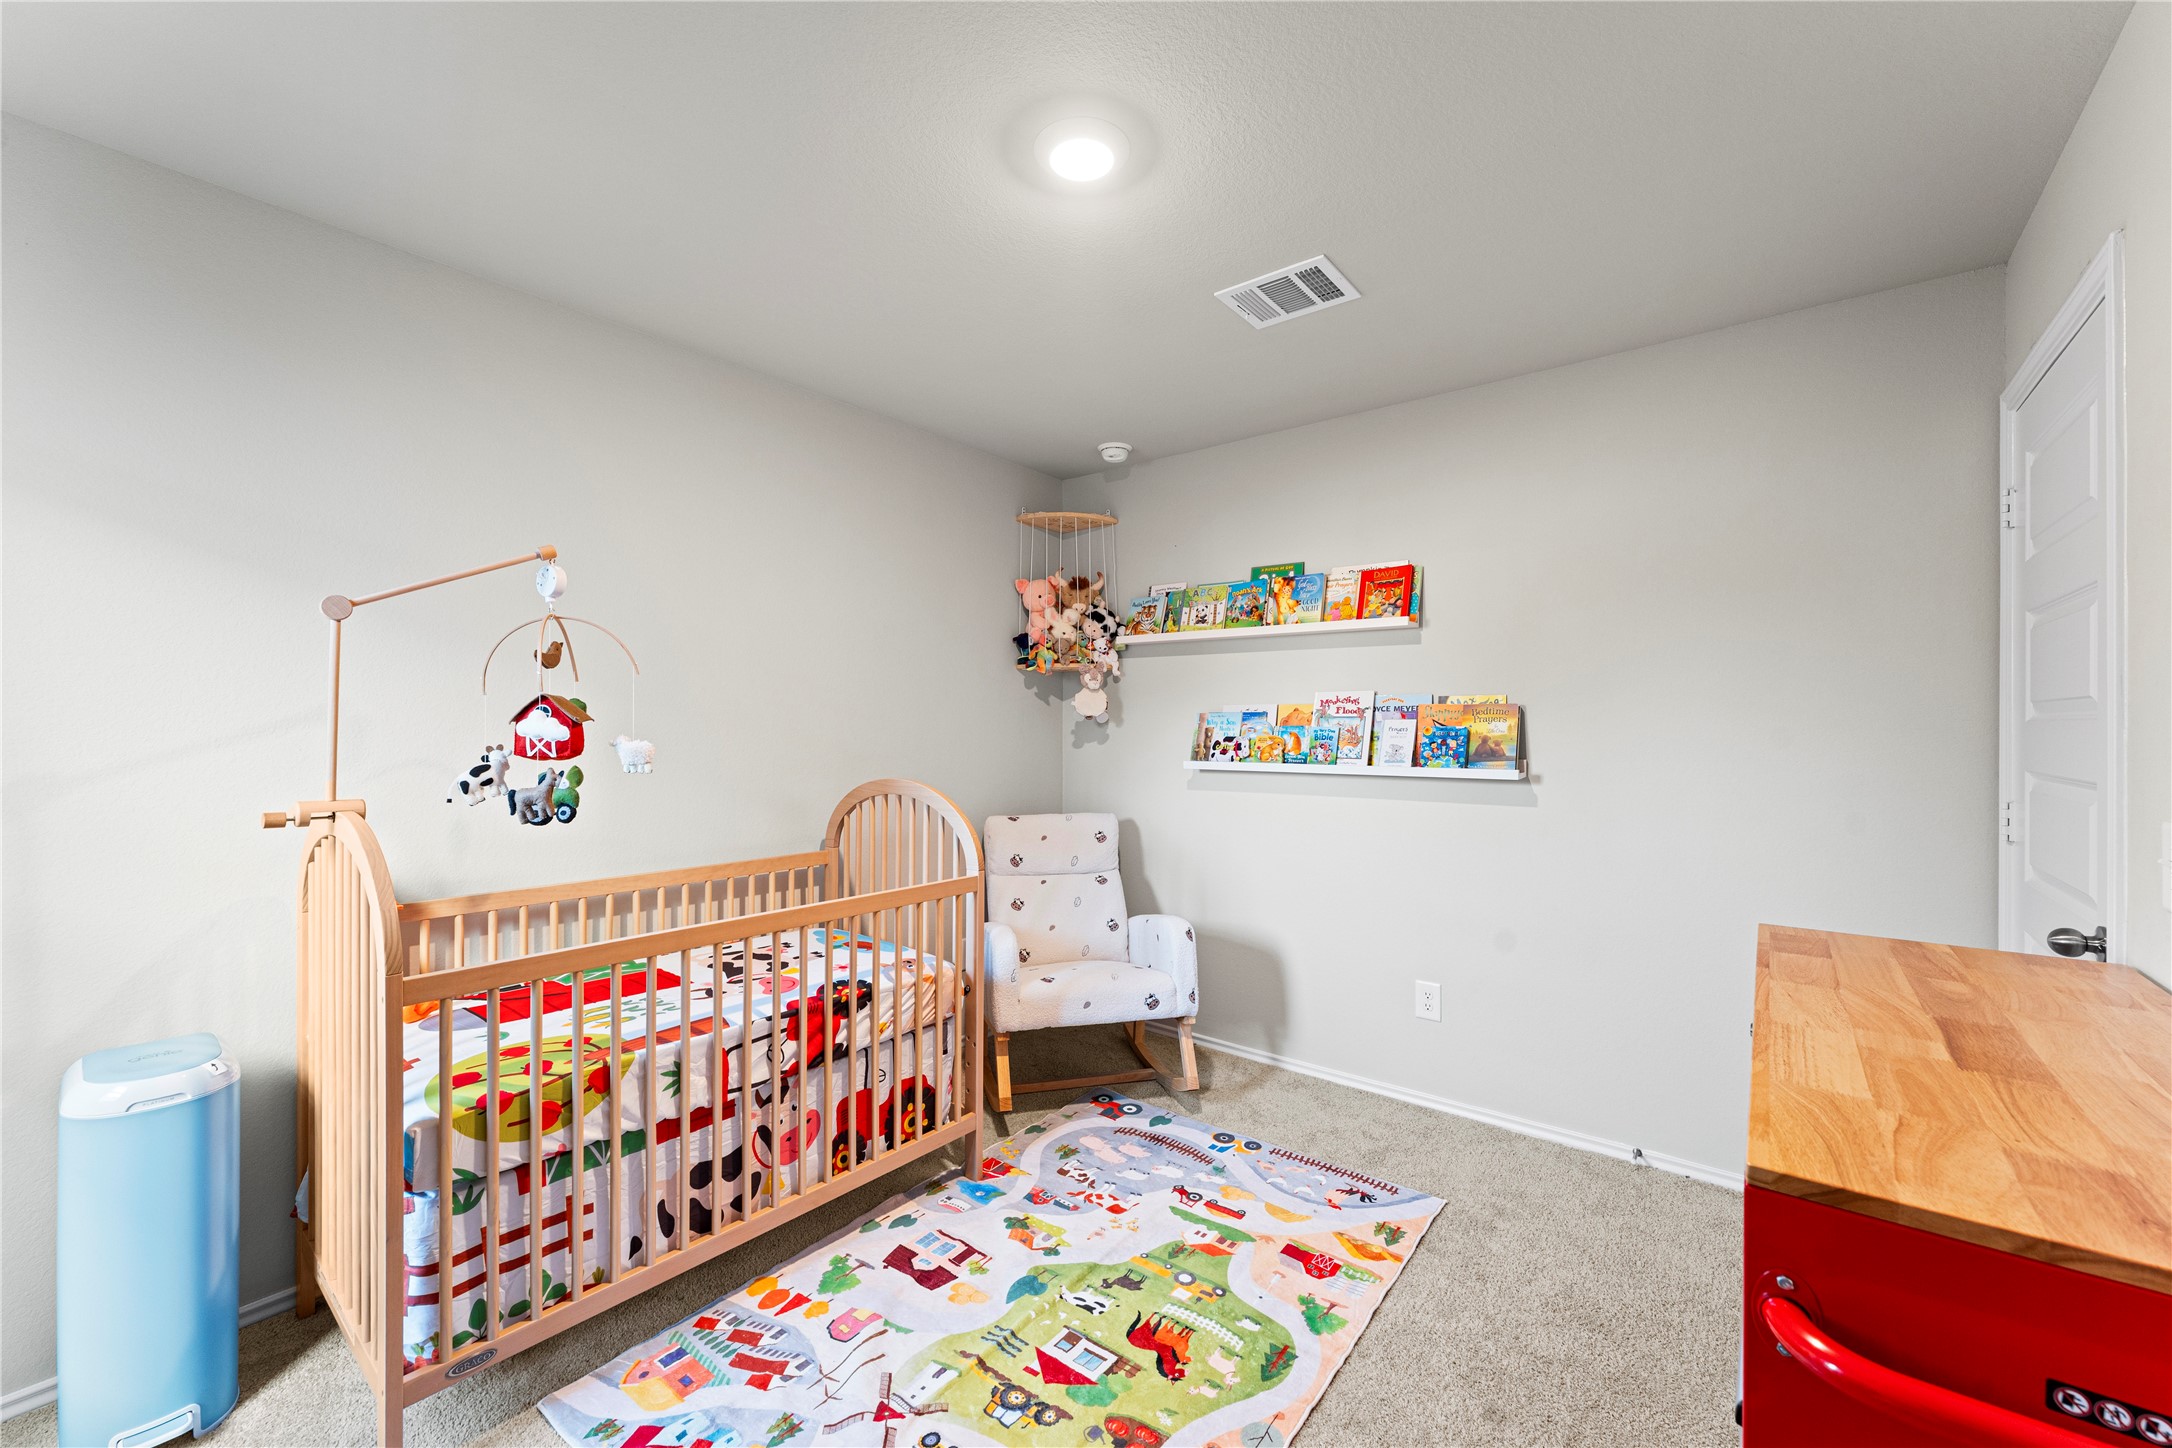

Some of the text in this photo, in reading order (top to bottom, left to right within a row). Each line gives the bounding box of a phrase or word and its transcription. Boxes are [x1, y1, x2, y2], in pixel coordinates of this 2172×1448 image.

[1373, 569, 1400, 579] DAVID
[1302, 597, 1319, 605] GOOD
[1471, 707, 1510, 717] Bedtime
[1473, 715, 1508, 725] Prayers
[1314, 733, 1334, 741] Bible
[142, 1097, 175, 1106] PLATINUM
[455, 1352, 491, 1373] GRACO
